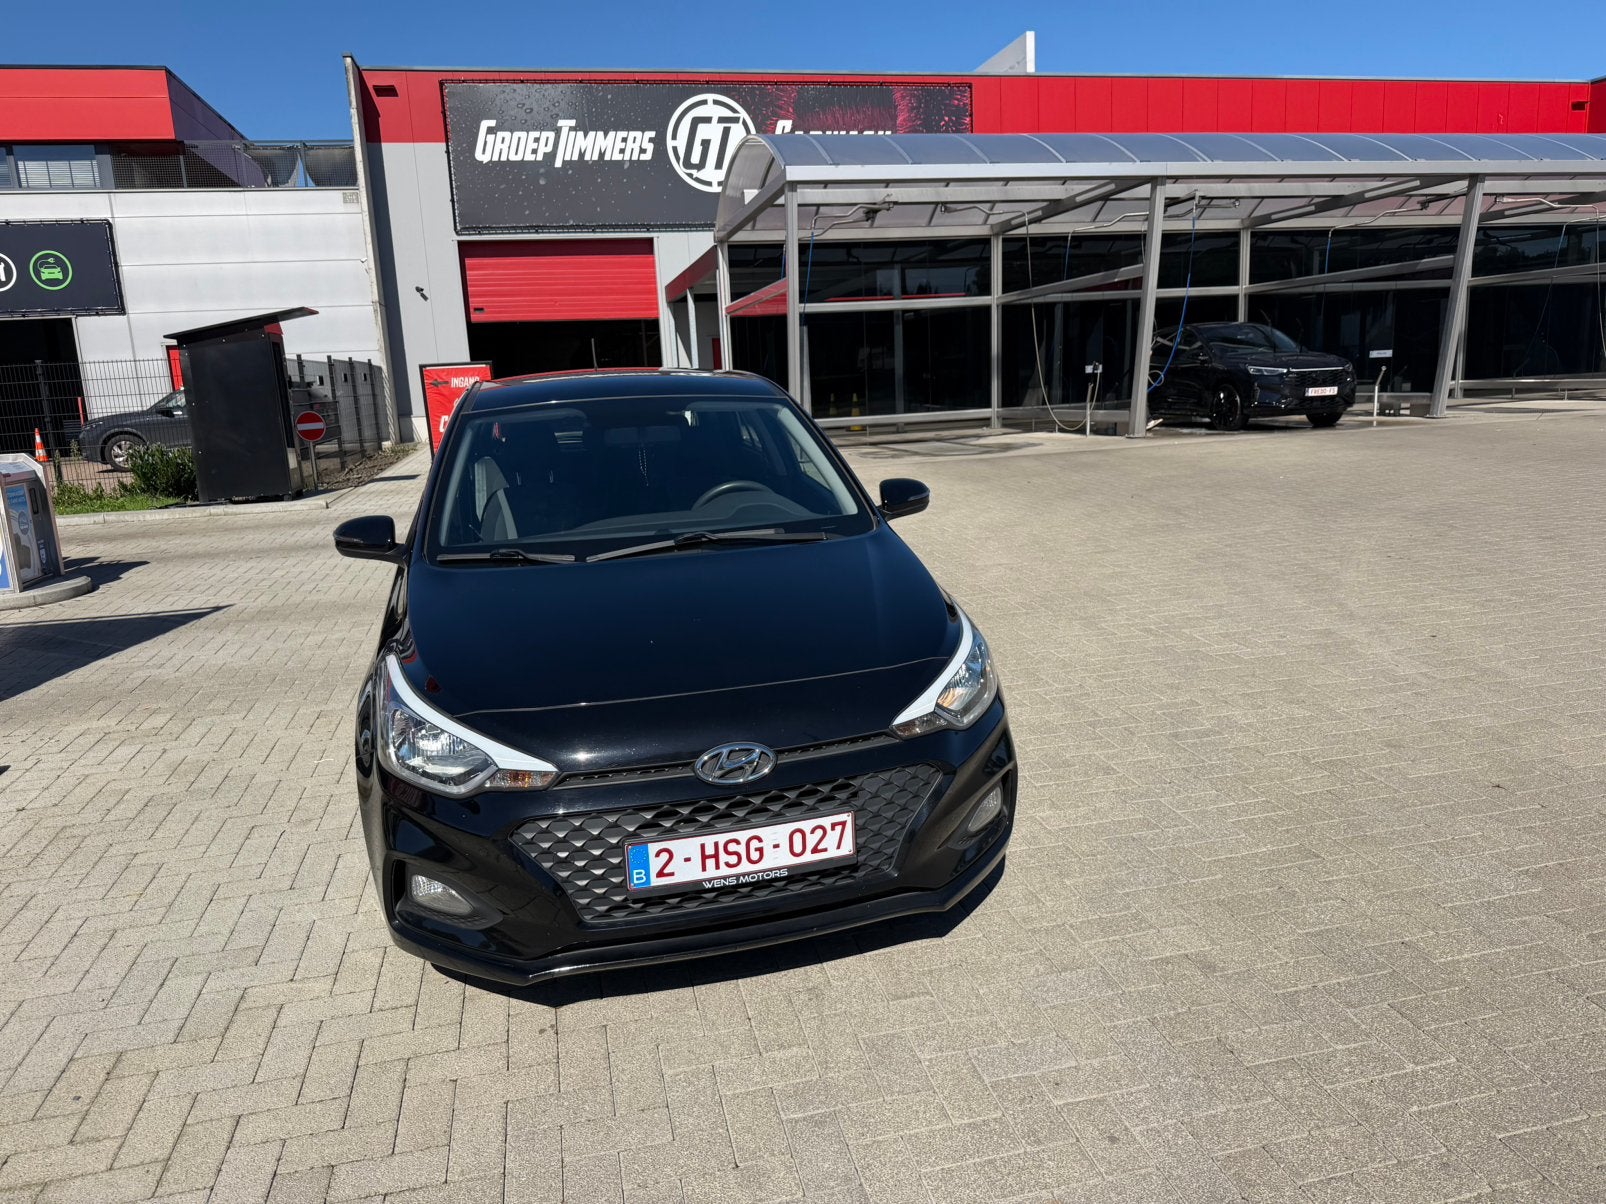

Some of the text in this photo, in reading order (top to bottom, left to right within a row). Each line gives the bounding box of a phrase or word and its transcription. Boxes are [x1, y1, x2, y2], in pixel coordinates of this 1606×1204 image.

[475, 119, 656, 168] GROEP TIMMERS
[682, 116, 741, 173] GT
[633, 870, 646, 884] B
[702, 868, 788, 889] WENS MOTORS
